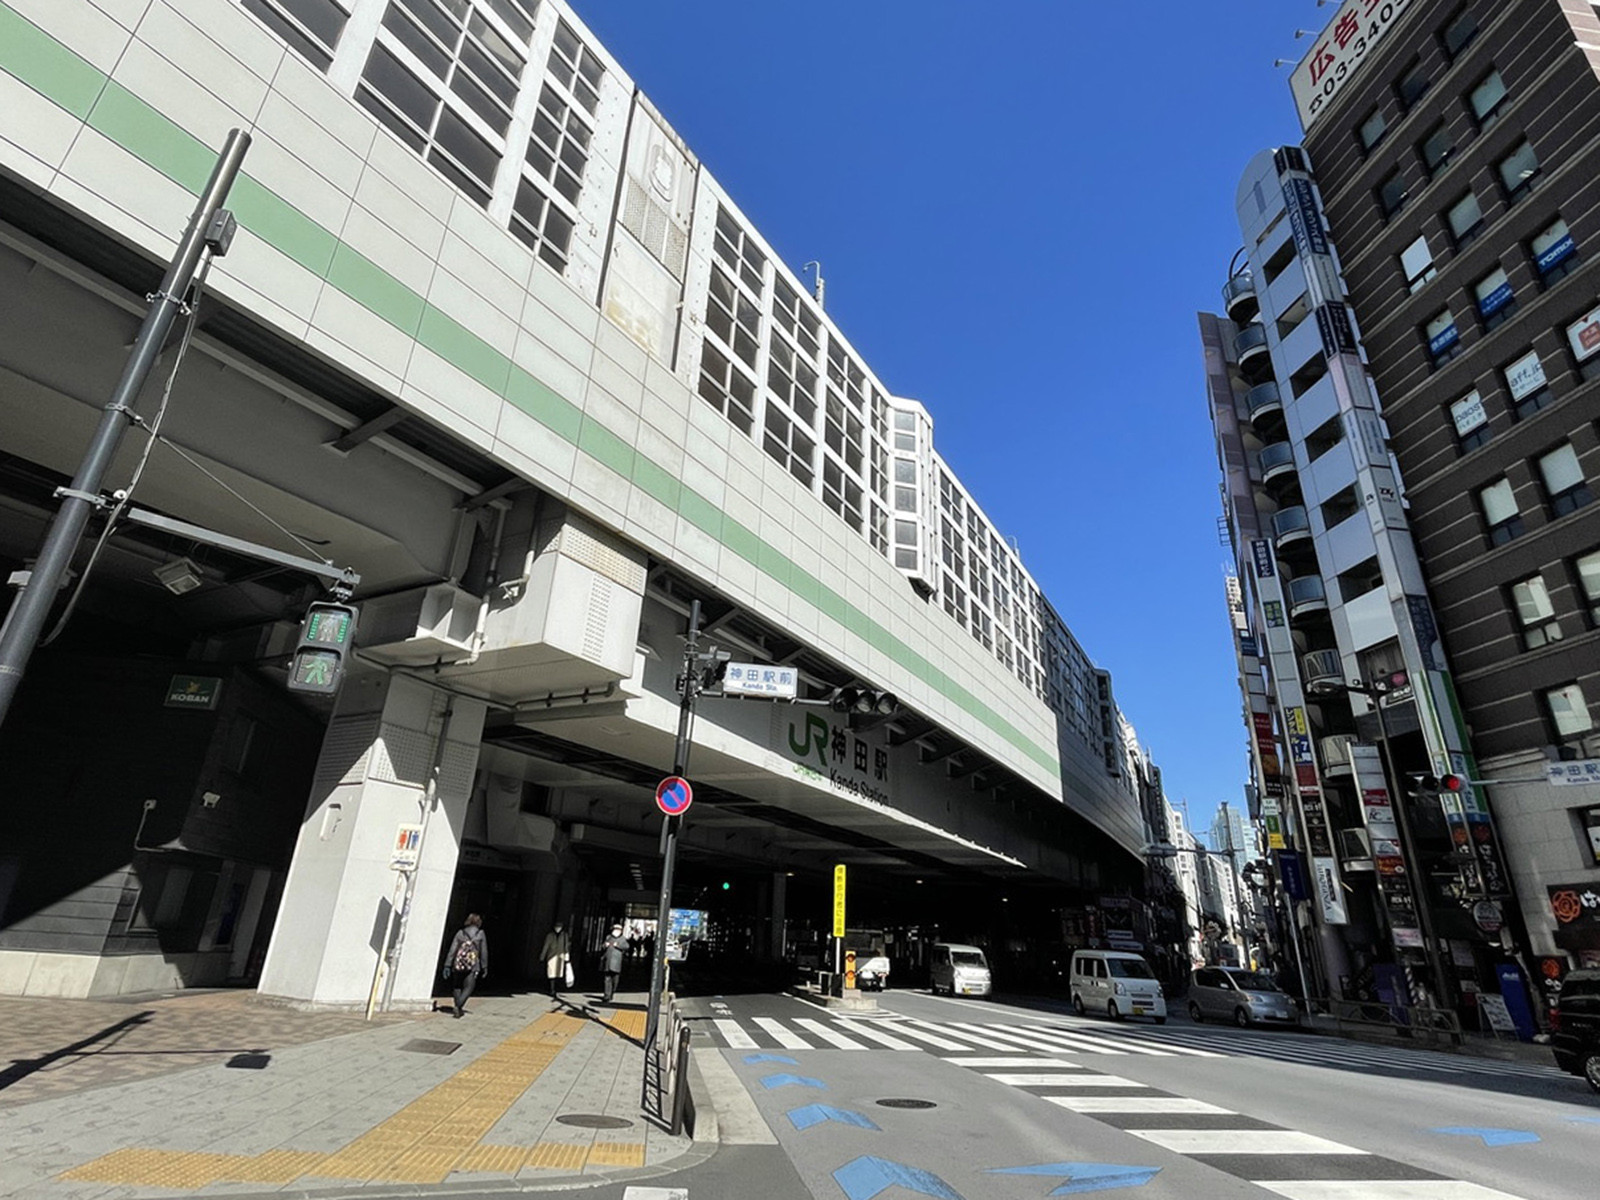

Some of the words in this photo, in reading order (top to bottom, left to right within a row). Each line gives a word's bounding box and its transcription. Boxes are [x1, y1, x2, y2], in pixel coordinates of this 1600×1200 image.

[730, 667, 792, 685] 神田駅前
[743, 683, 764, 691] Kanda
[766, 684, 778, 692] Sta.
[171, 693, 209, 702] KOBAN
[788, 711, 829, 767] JR
[831, 726, 888, 781] 神田駅
[830, 767, 859, 797] Kanda
[859, 780, 890, 807] Station
